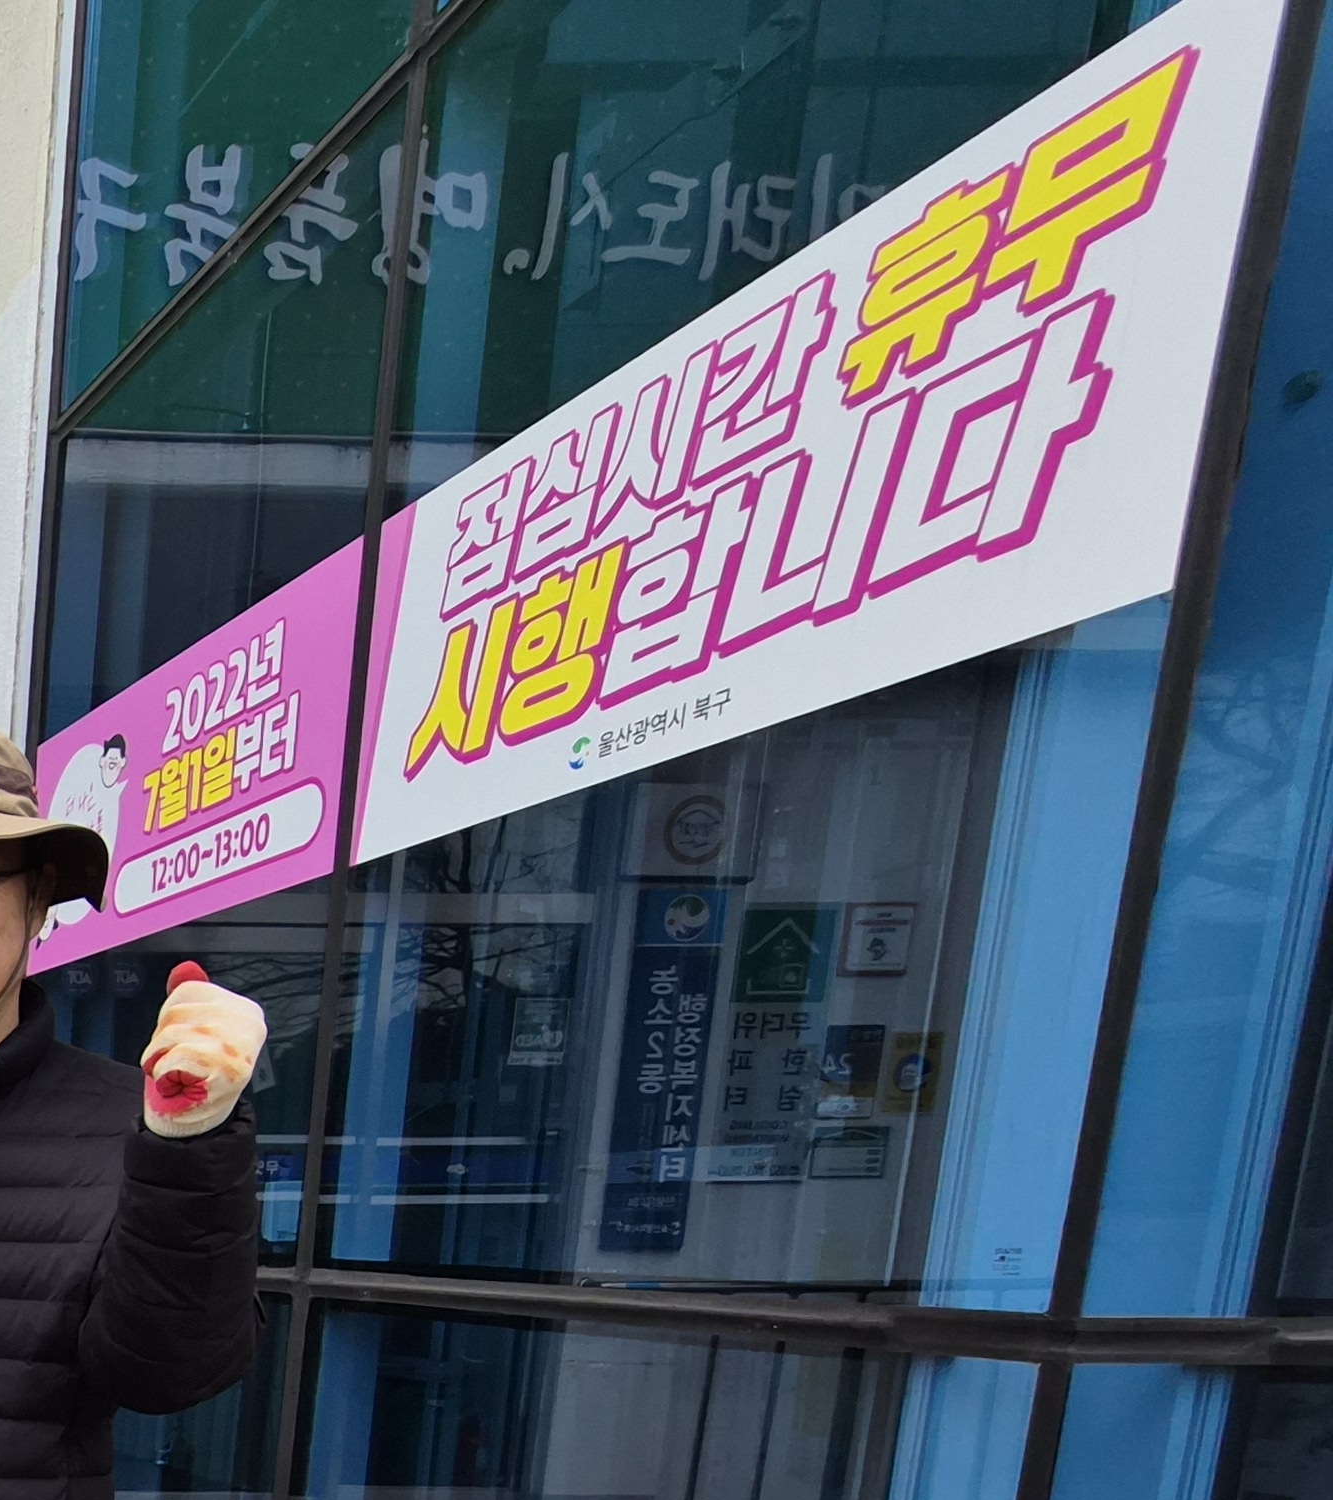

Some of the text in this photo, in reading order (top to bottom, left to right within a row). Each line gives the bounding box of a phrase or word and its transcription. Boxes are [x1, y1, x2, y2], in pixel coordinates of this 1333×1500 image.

[440, 44, 1200, 622] 점심시간 휴무
[403, 290, 1115, 781] 시행합니다
[161, 617, 287, 756] 2022년
[597, 687, 732, 759] 울산광역시 북구
[141, 689, 301, 836] 7월1일부터
[150, 812, 271, 894] 12:00~13:00
